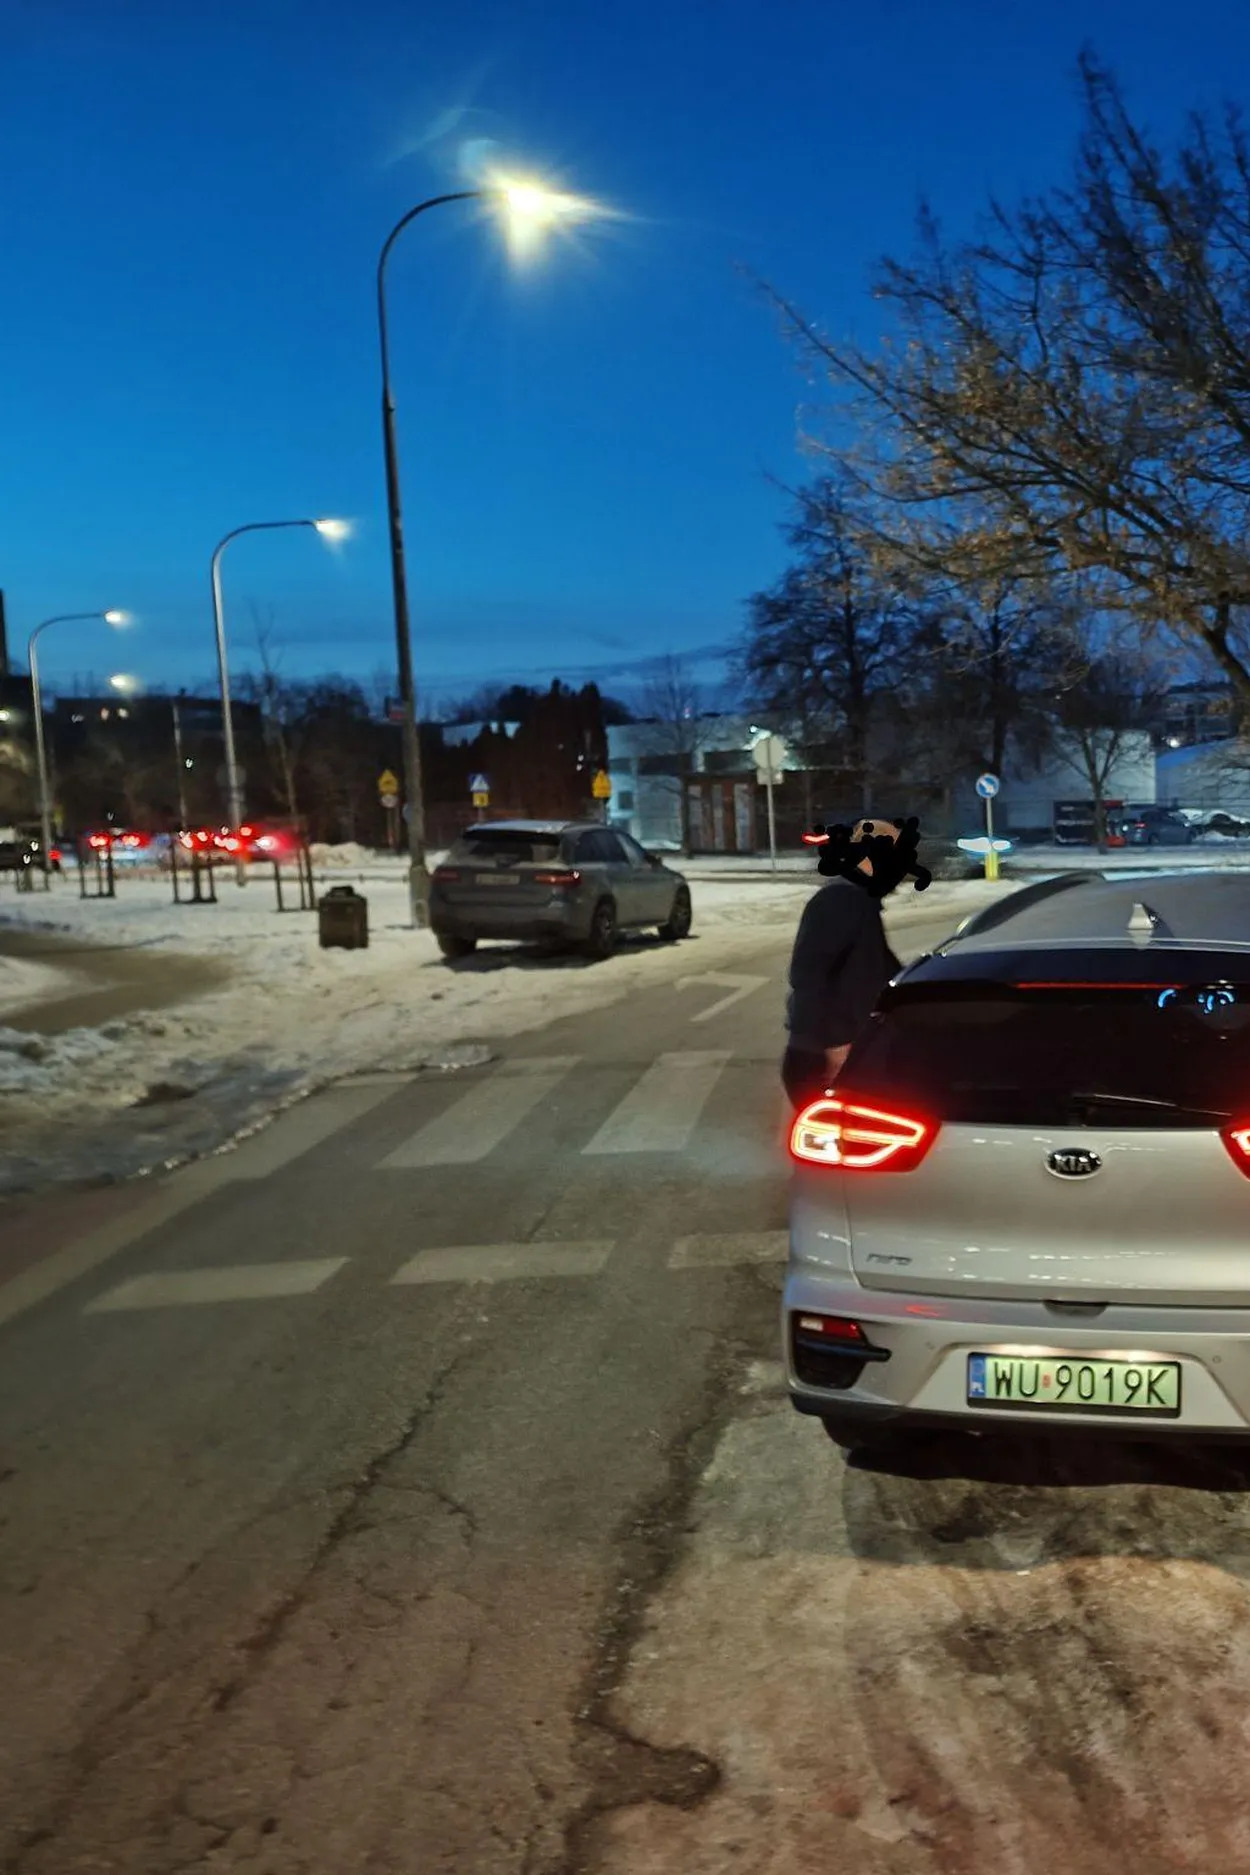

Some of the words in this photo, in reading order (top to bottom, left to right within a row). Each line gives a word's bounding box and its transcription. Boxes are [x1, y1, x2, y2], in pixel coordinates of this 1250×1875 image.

[1053, 1153, 1092, 1172] KIA
[994, 1361, 1039, 1397] WU
[1055, 1364, 1169, 1405] 9019K
